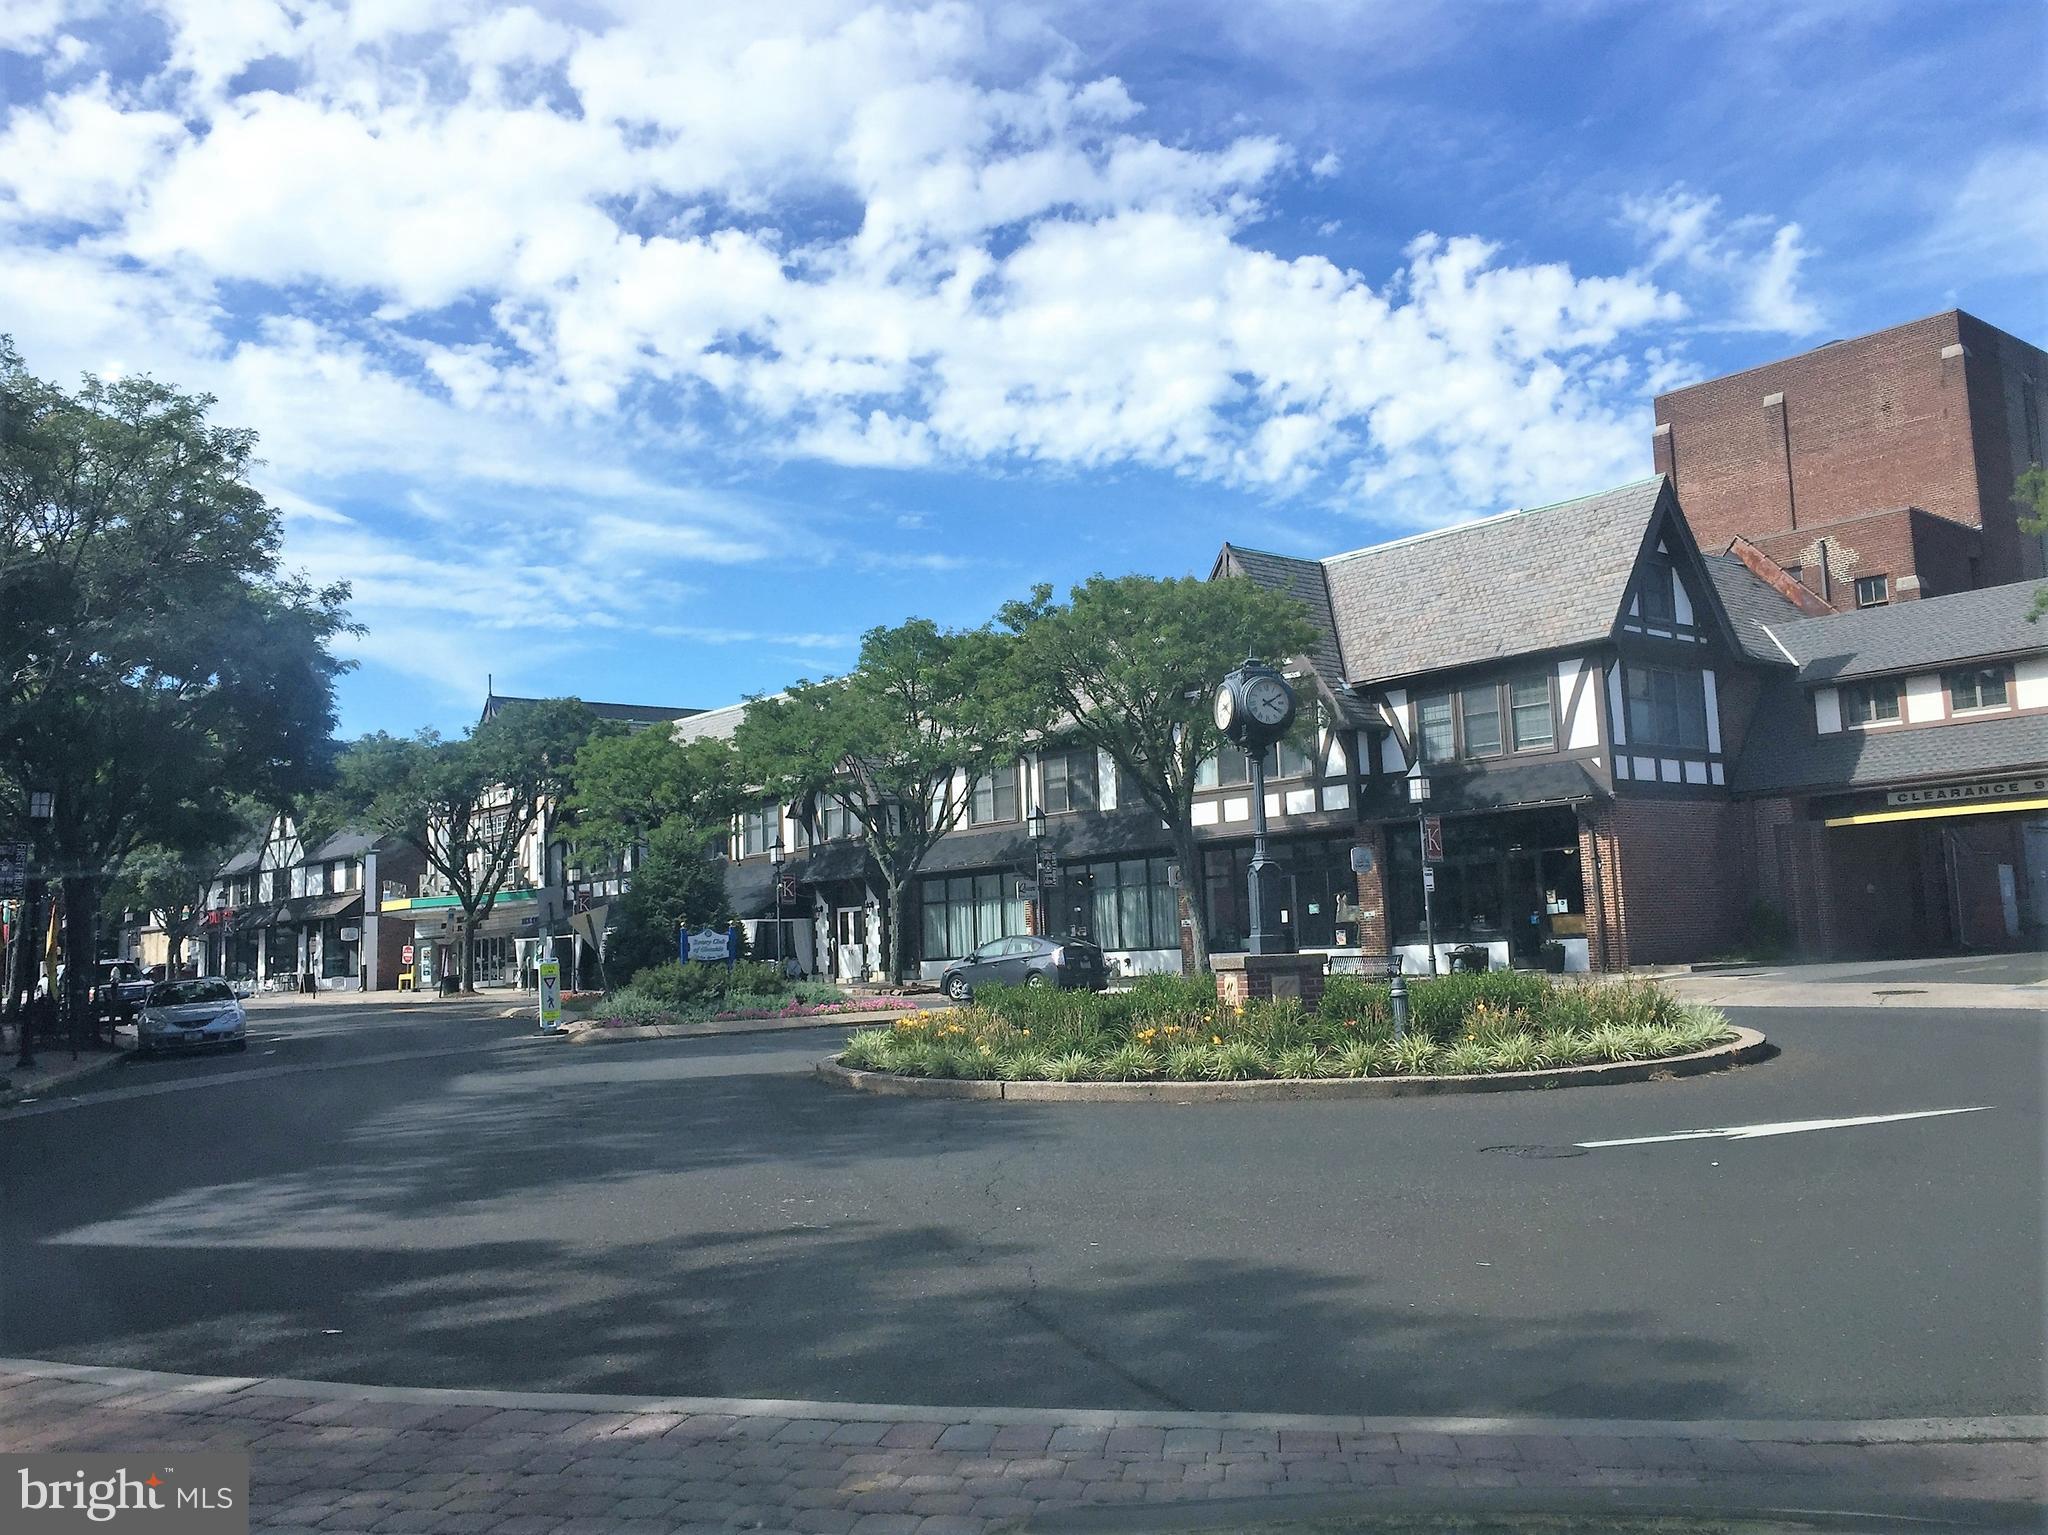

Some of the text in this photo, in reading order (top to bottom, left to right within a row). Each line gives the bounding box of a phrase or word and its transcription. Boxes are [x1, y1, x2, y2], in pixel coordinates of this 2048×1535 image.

[1897, 783, 2019, 802] CLEARANCE
[1427, 828, 1441, 850] K
[783, 881, 794, 897] K
[579, 897, 591, 912] K
